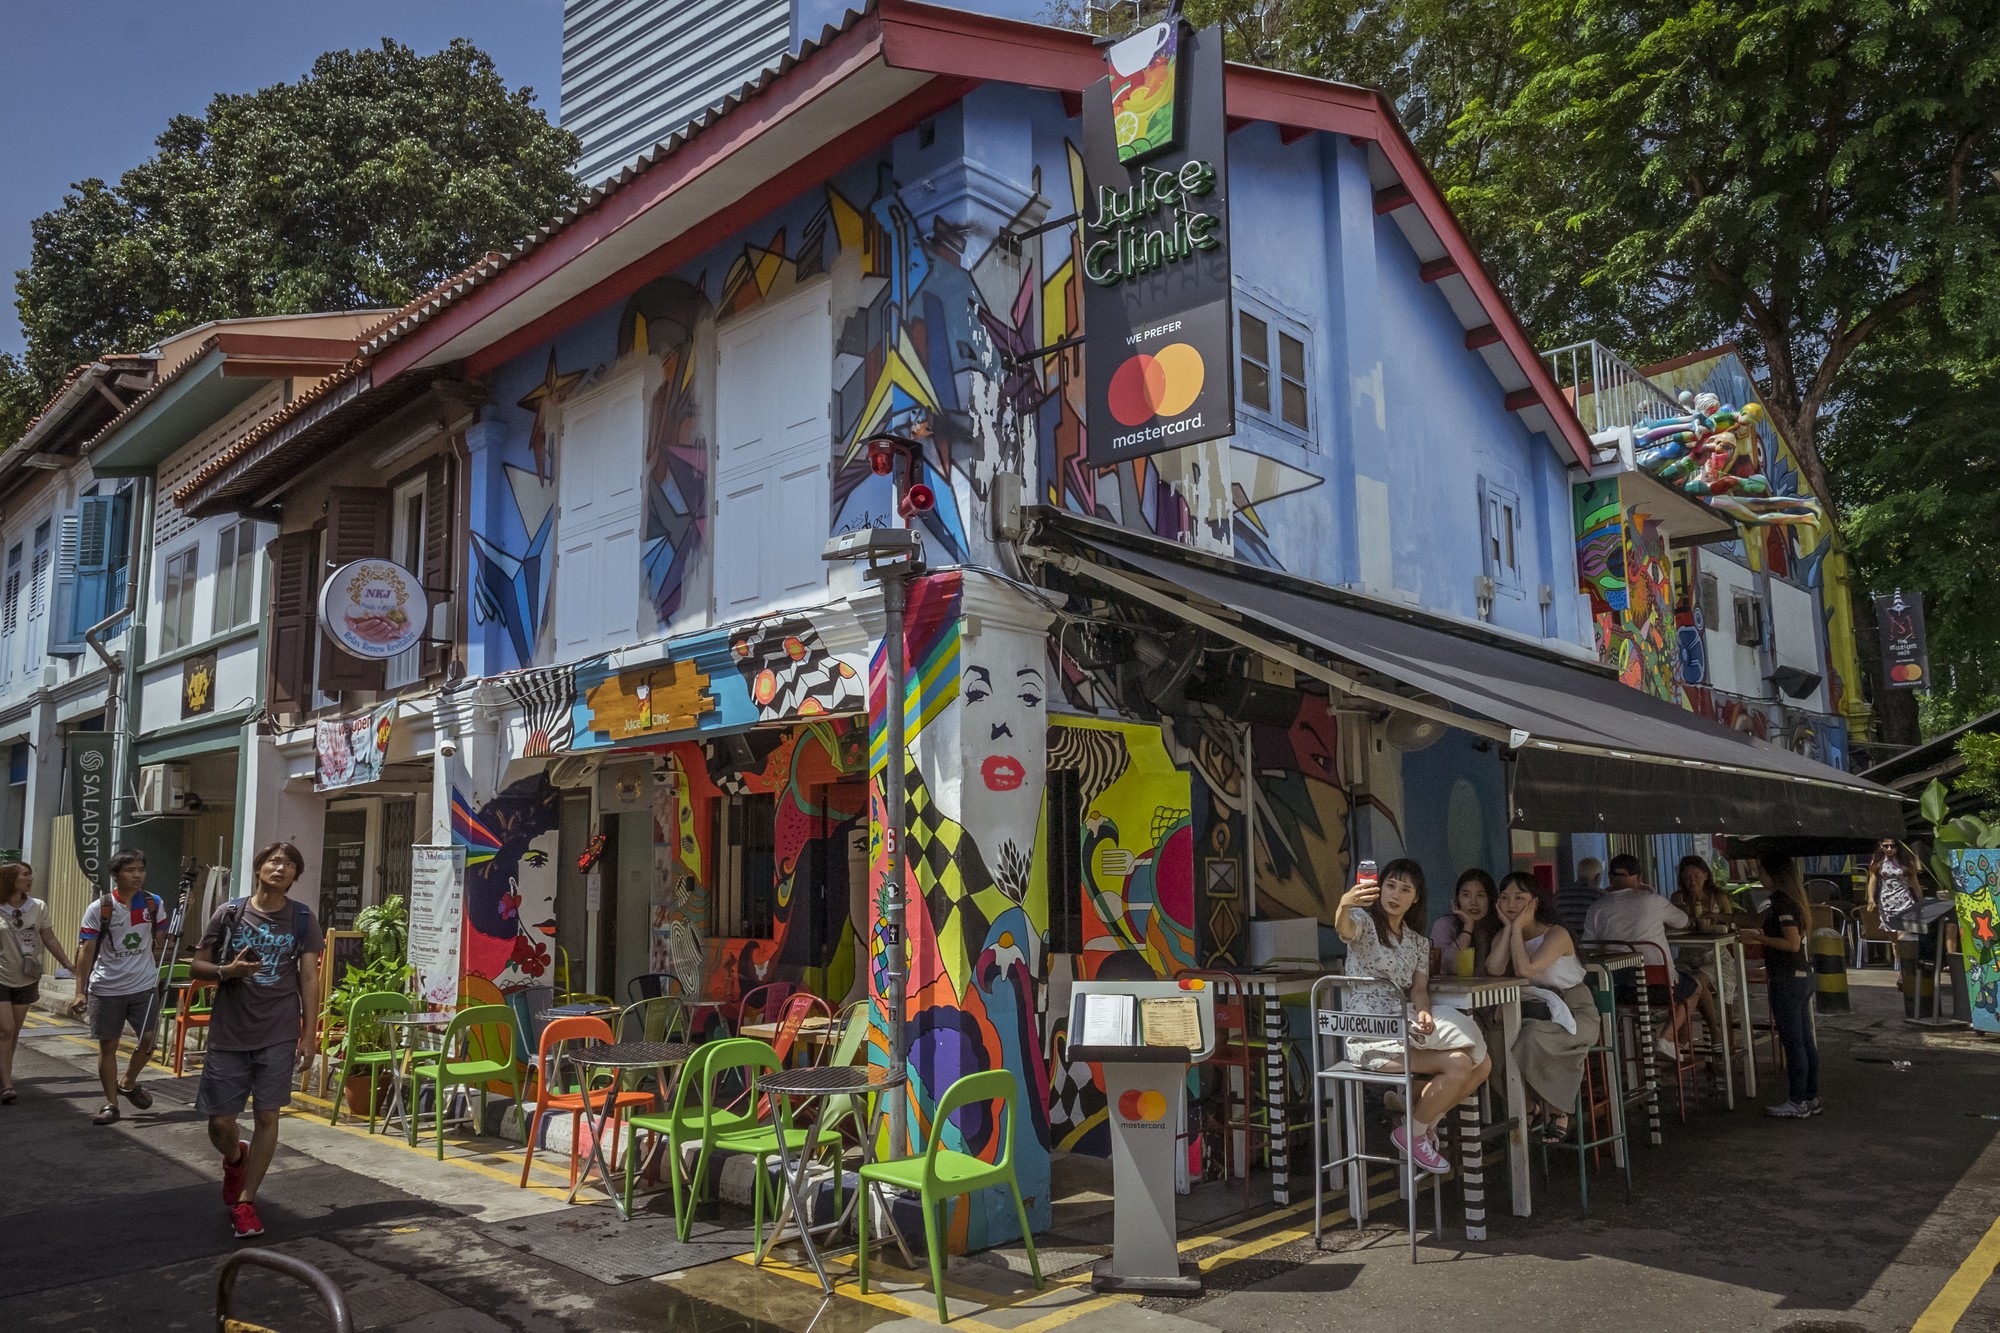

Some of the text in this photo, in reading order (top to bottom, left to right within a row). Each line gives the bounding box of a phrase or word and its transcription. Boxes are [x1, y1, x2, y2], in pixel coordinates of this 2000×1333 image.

[1088, 160, 1215, 232] Juice
[1085, 207, 1219, 286] Clinic
[1125, 321, 1182, 346] WE PREFER
[365, 588, 392, 599] NKJ
[343, 631, 416, 653] Relax Renew Revitalize
[624, 713, 670, 731] Juice Clinic
[335, 938, 361, 956] NK
[1121, 1122, 1166, 1130] mastercard
